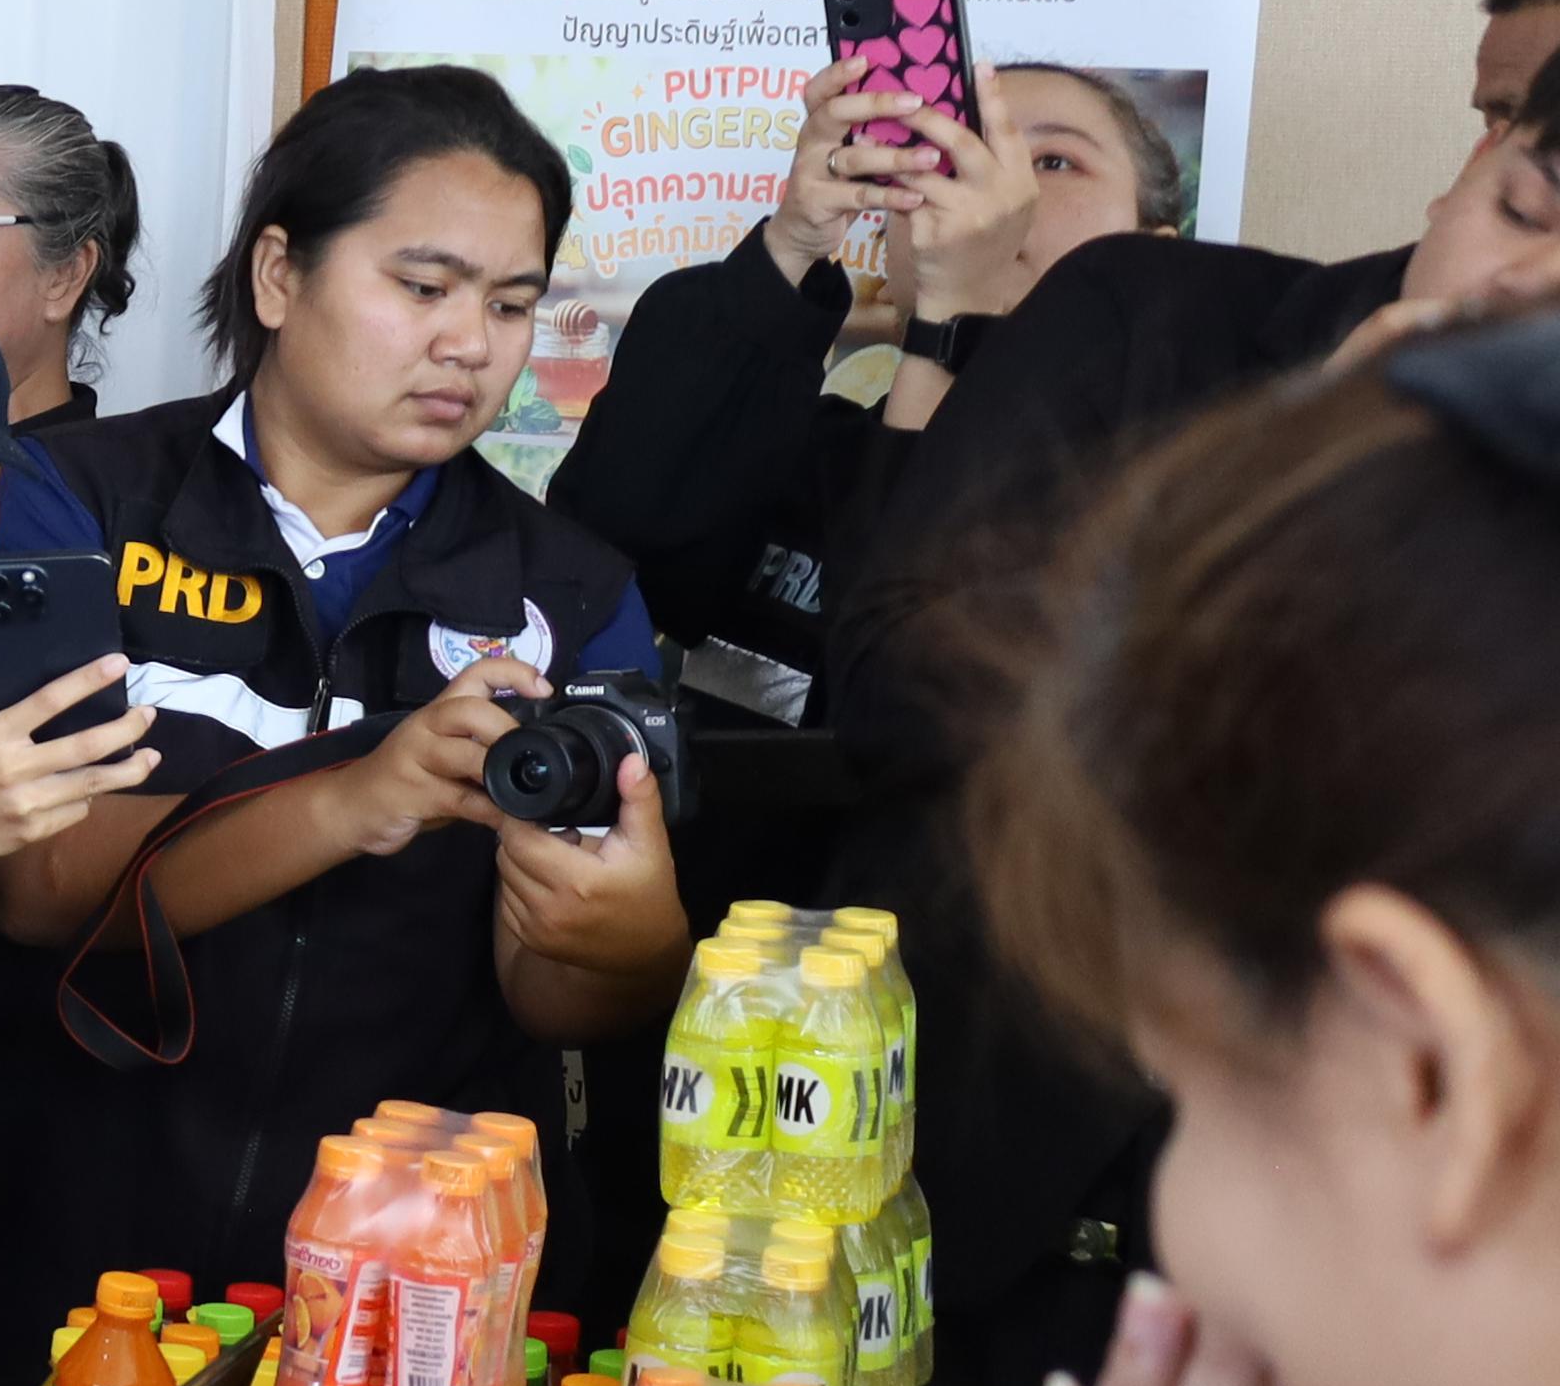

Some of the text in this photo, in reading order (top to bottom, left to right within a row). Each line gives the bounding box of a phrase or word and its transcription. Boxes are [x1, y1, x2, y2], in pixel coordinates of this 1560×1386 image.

[561, 11, 832, 52] ปัญญาประดิษฐ์เพื่อตลา
[664, 65, 811, 103] PUTPUR
[601, 105, 801, 158] GINGERS
[116, 540, 264, 625] PRD
[564, 683, 605, 697] Canon
[644, 716, 667, 727] EOS
[775, 1072, 821, 1126] MK
